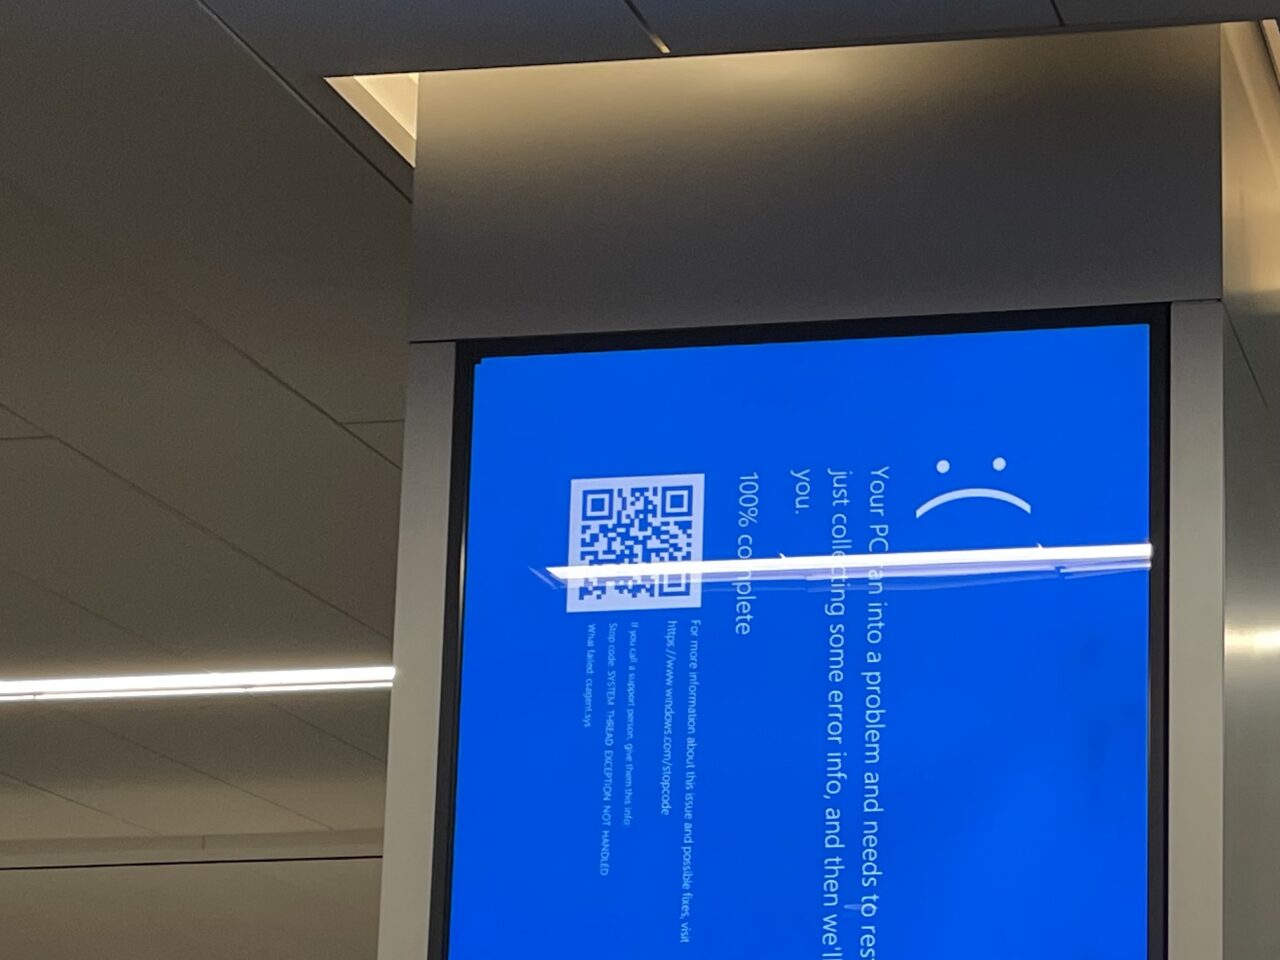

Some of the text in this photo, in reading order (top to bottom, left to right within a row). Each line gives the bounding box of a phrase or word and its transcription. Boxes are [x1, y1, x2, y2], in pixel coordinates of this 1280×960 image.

[738, 472, 760, 528] 100%
[791, 468, 810, 513] you.
[828, 468, 852, 507] just
[869, 466, 890, 516] Your
[868, 525, 891, 556] PC
[607, 622, 619, 643] Stop
[627, 629, 638, 647] you
[690, 619, 702, 637] For
[866, 602, 887, 643] into
[628, 647, 639, 663] call
[688, 640, 699, 670] more
[829, 623, 845, 683] some
[866, 652, 881, 663] a
[626, 672, 636, 707] support
[686, 672, 700, 734] information
[827, 690, 844, 745] error
[861, 671, 886, 764] problem
[623, 743, 634, 762] give
[685, 737, 698, 769] about
[623, 764, 634, 787] them
[684, 771, 697, 790] this
[824, 752, 848, 799] info,
[864, 771, 884, 813] and
[623, 788, 634, 805] this
[683, 793, 696, 820] issue
[683, 822, 695, 844] and
[824, 807, 846, 849] and
[680, 846, 694, 890] possible
[862, 821, 883, 887] needs
[823, 856, 845, 907] then
[860, 893, 880, 918] to
[679, 921, 692, 944] visit
